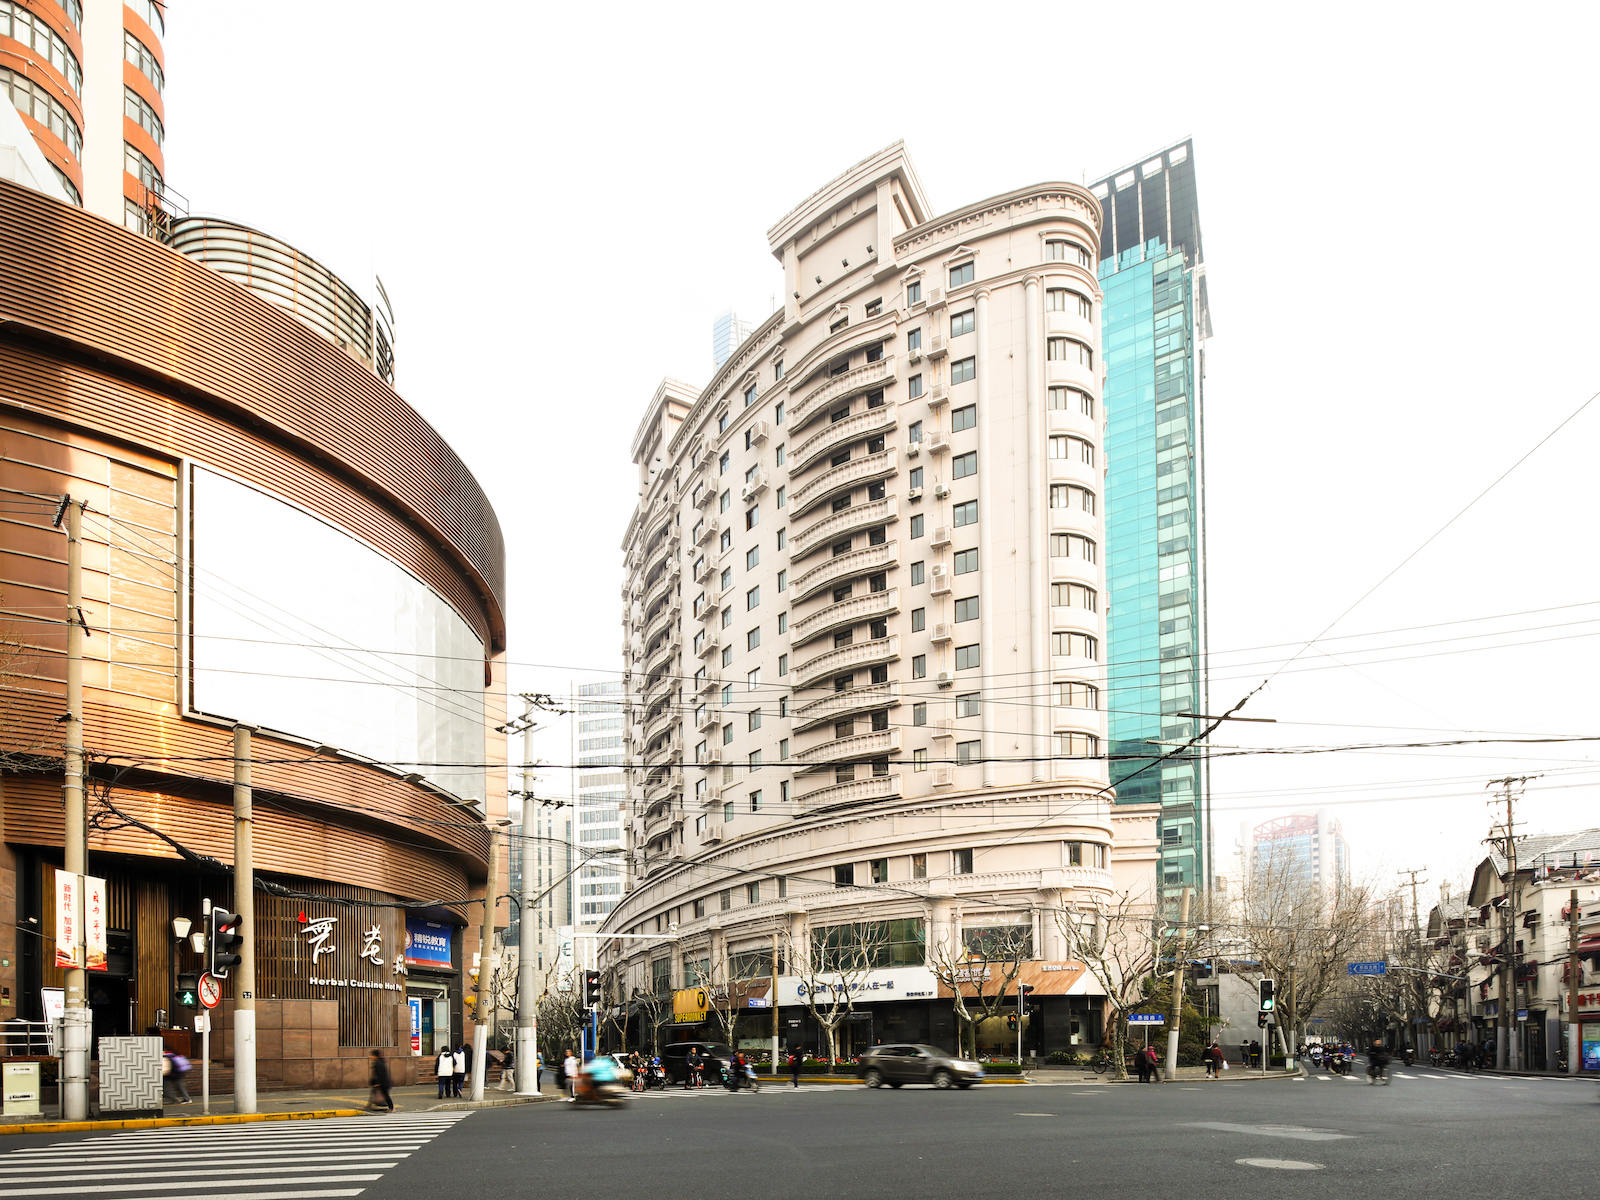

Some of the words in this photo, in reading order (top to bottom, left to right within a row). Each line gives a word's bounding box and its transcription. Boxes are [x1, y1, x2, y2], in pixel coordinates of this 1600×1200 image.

[63, 883, 72, 912] 新时代
[63, 916, 73, 944] 加油干
[309, 977, 348, 987] Herbal
[350, 979, 383, 989] Cuisine
[384, 982, 395, 990] Hot
[674, 1011, 707, 1023] SUPERMONKEY
